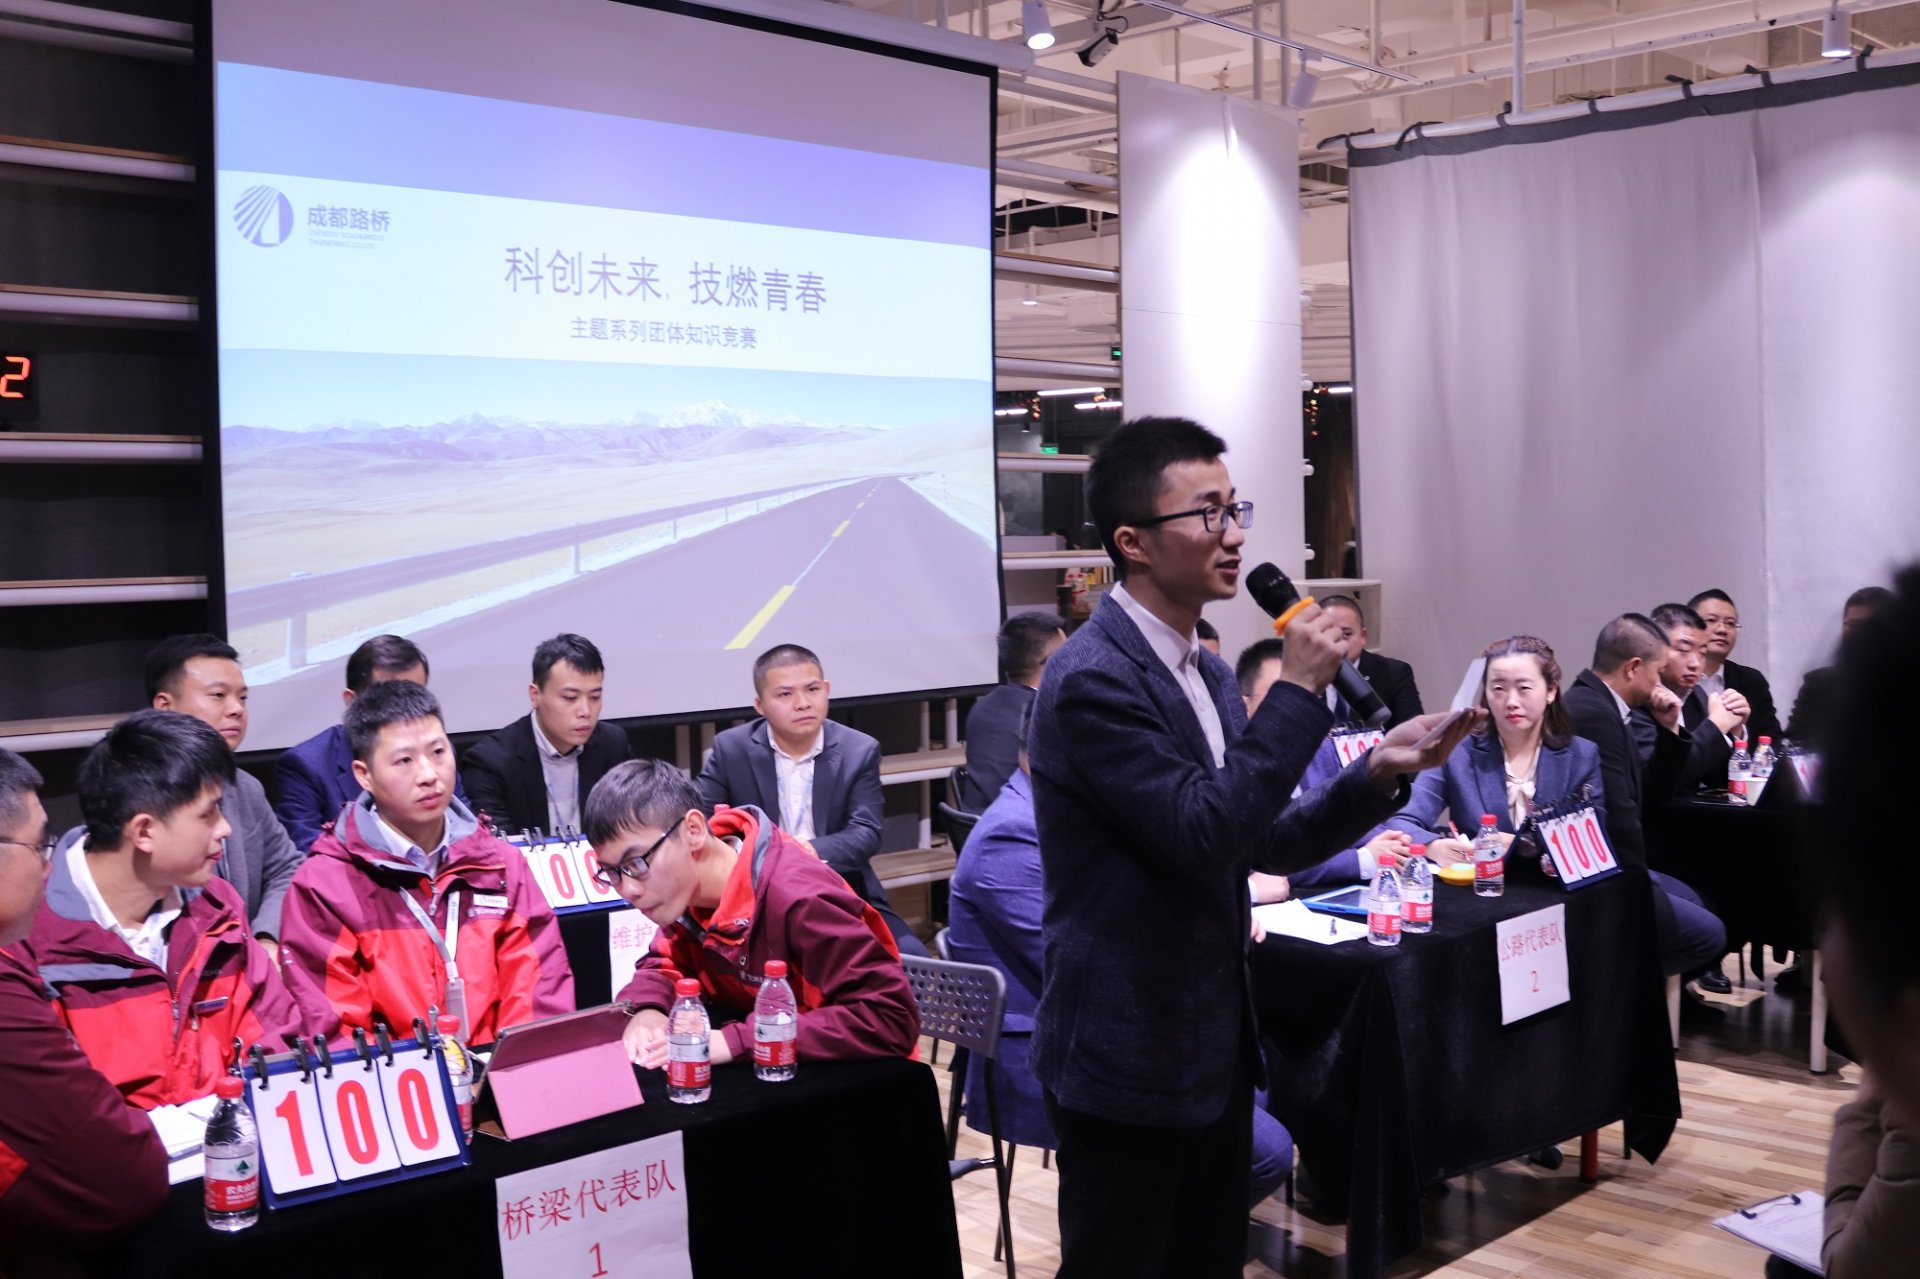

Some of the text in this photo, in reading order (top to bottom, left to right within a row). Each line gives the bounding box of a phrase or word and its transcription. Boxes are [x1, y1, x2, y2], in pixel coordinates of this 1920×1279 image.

[307, 204, 390, 232] 成都路桥
[570, 317, 758, 349] 主题系列团体知识竞赛
[0, 356, 31, 398] 2
[1551, 818, 1608, 876] 100
[1531, 969, 1541, 993] 2
[275, 1068, 440, 1177] 100
[502, 1159, 677, 1241] 桥梁代表队
[588, 1242, 609, 1279] 1
